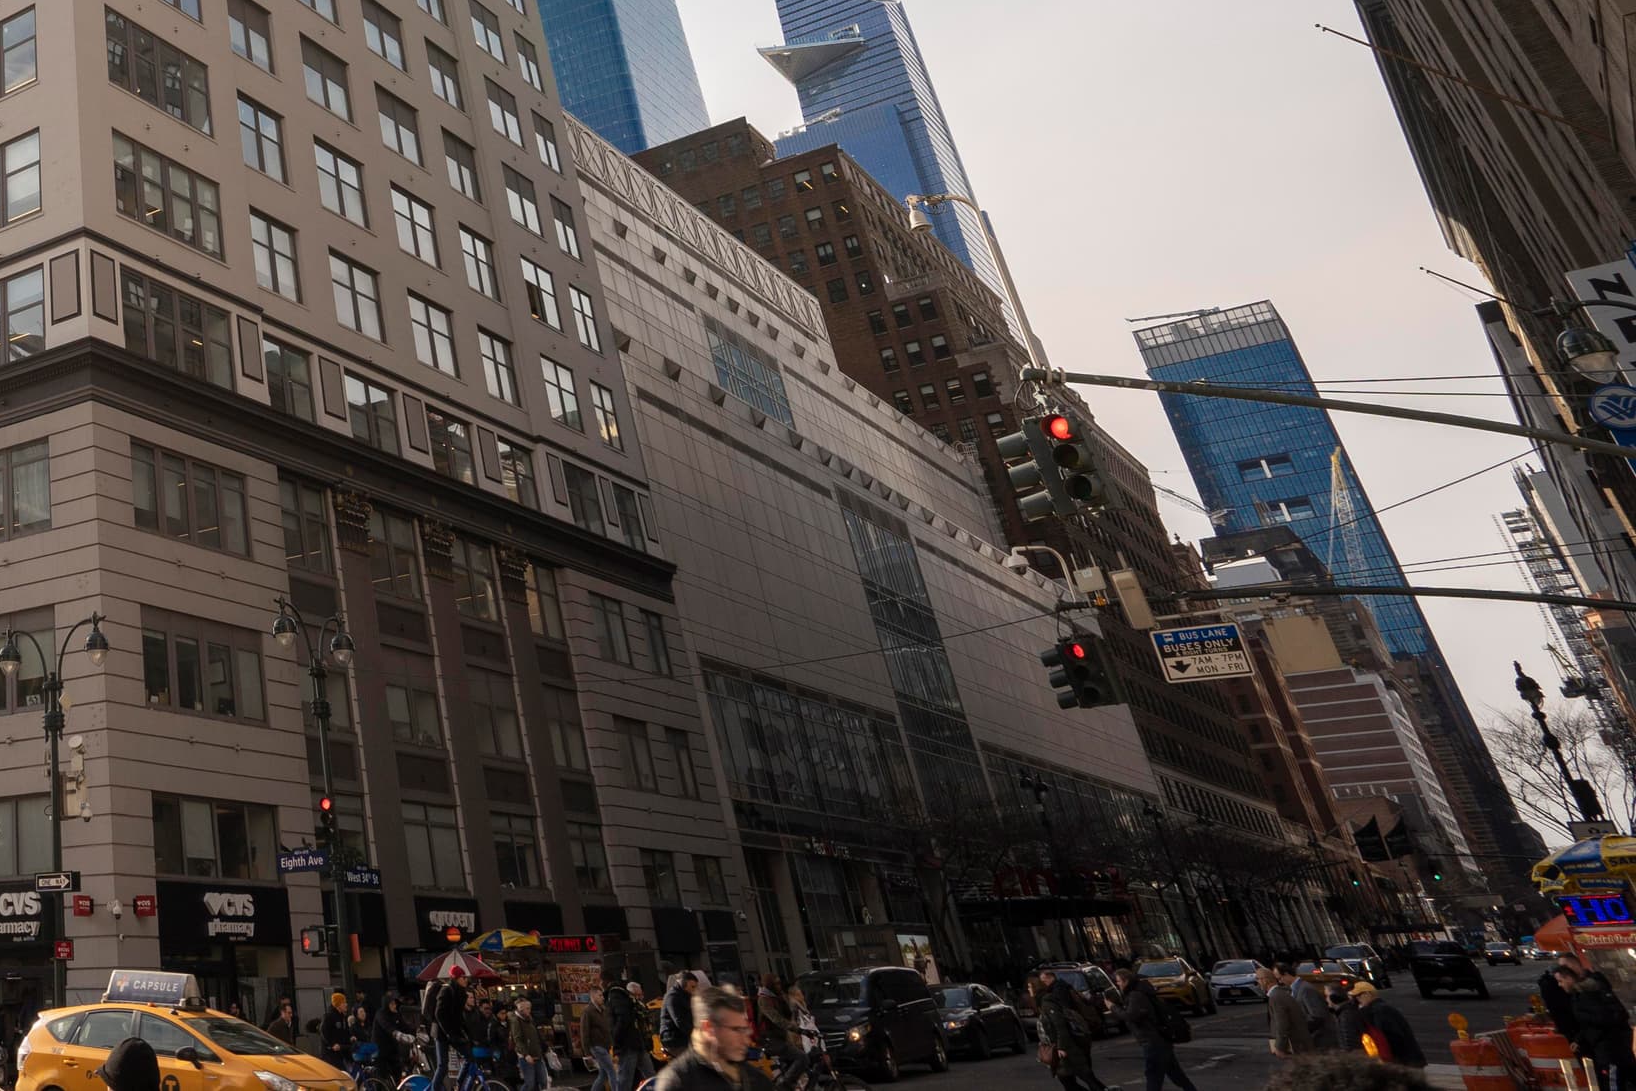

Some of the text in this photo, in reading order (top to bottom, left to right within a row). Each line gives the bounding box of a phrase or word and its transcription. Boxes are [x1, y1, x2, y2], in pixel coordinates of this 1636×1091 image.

[1178, 628, 1228, 641] BUS LANE
[1163, 638, 1234, 653] BUSES ONLY
[1190, 655, 1213, 665] 7AM
[1220, 653, 1243, 663] 7PM
[1196, 664, 1219, 674] MON
[1227, 662, 1245, 671] FRI
[280, 855, 324, 870] Eighth Ave
[346, 871, 361, 883] West
[221, 893, 255, 917] CVS
[207, 918, 255, 938] pharmacy
[429, 910, 475, 933] grocery
[132, 979, 180, 993] CAPSULE
